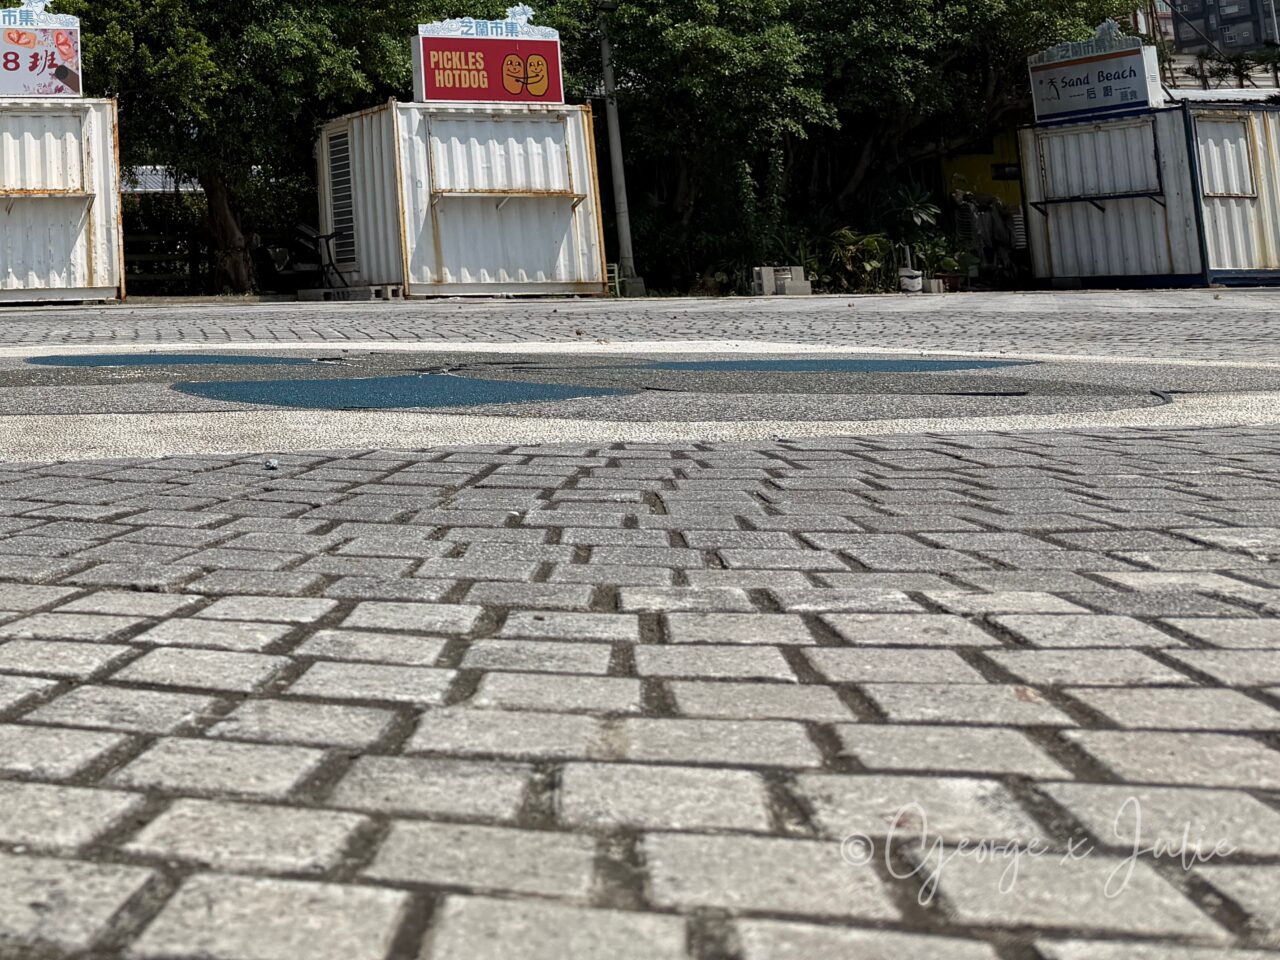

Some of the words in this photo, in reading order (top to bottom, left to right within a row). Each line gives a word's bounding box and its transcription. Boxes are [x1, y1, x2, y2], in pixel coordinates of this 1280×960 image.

[460, 19, 520, 37] 芝蘭市集
[429, 50, 485, 70] PICKLES
[435, 69, 489, 89] HOTDOG
[1061, 73, 1090, 88] Sand
[1097, 66, 1137, 83] Beach
